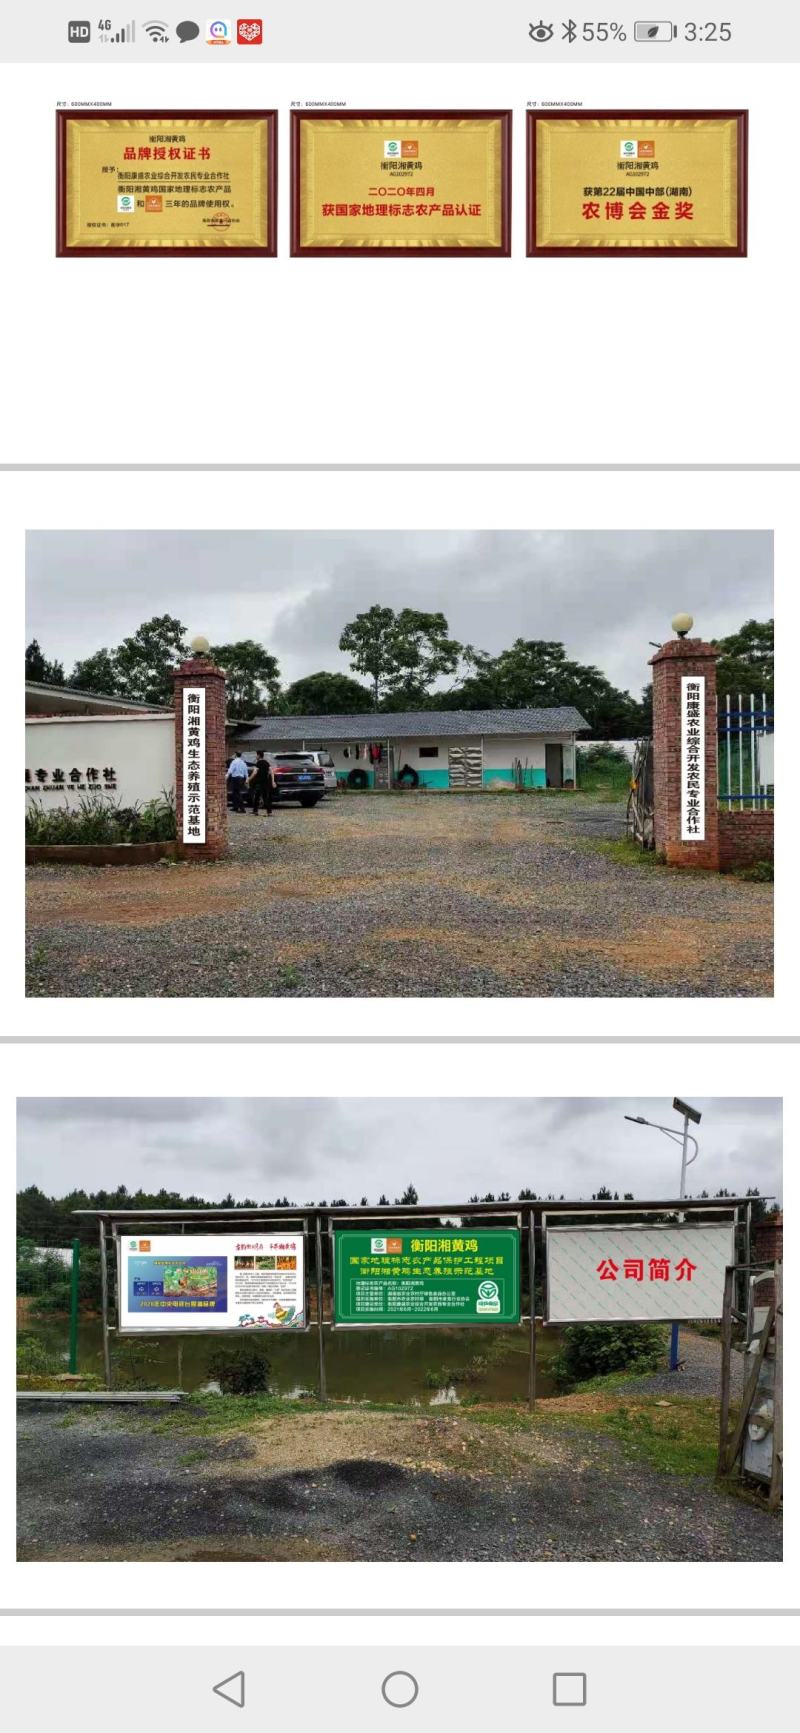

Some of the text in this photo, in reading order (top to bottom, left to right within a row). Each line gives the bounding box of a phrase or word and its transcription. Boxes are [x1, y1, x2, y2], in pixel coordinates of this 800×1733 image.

[98, 19, 112, 31] 4G
[70, 27, 89, 38] HD
[582, 22, 627, 42] 55%
[684, 22, 732, 42] 3:25
[149, 135, 186, 143] 衡阳湘黄鸡
[123, 147, 211, 161] 品牌授权证书
[380, 161, 422, 170] 衡阳湘黄鸡
[616, 161, 659, 170] 衡阳湘黄鸡
[117, 172, 230, 180] 衡阳康盛农业综合开发农民专业合作社
[118, 185, 232, 193] 衡阳湘黄鸡国家地理标志农产品
[137, 200, 144, 208] 和
[322, 204, 482, 216] 获国家地理标志农产品认证
[582, 202, 694, 220] 农博会金奖
[687, 683, 700, 834] 衡阳康盛农业综合开发农民专业合作社
[188, 693, 200, 837] 衡阳湘黄鸡生态养殖示范基地
[411, 1239, 478, 1252] 衡阳湘黄鸡
[350, 1256, 504, 1265] 国家地理标志农产品保护工程项目
[360, 1267, 494, 1276] 衡阳湘黄鸡生态养殖示范基地
[596, 1258, 697, 1281] 公司简介
